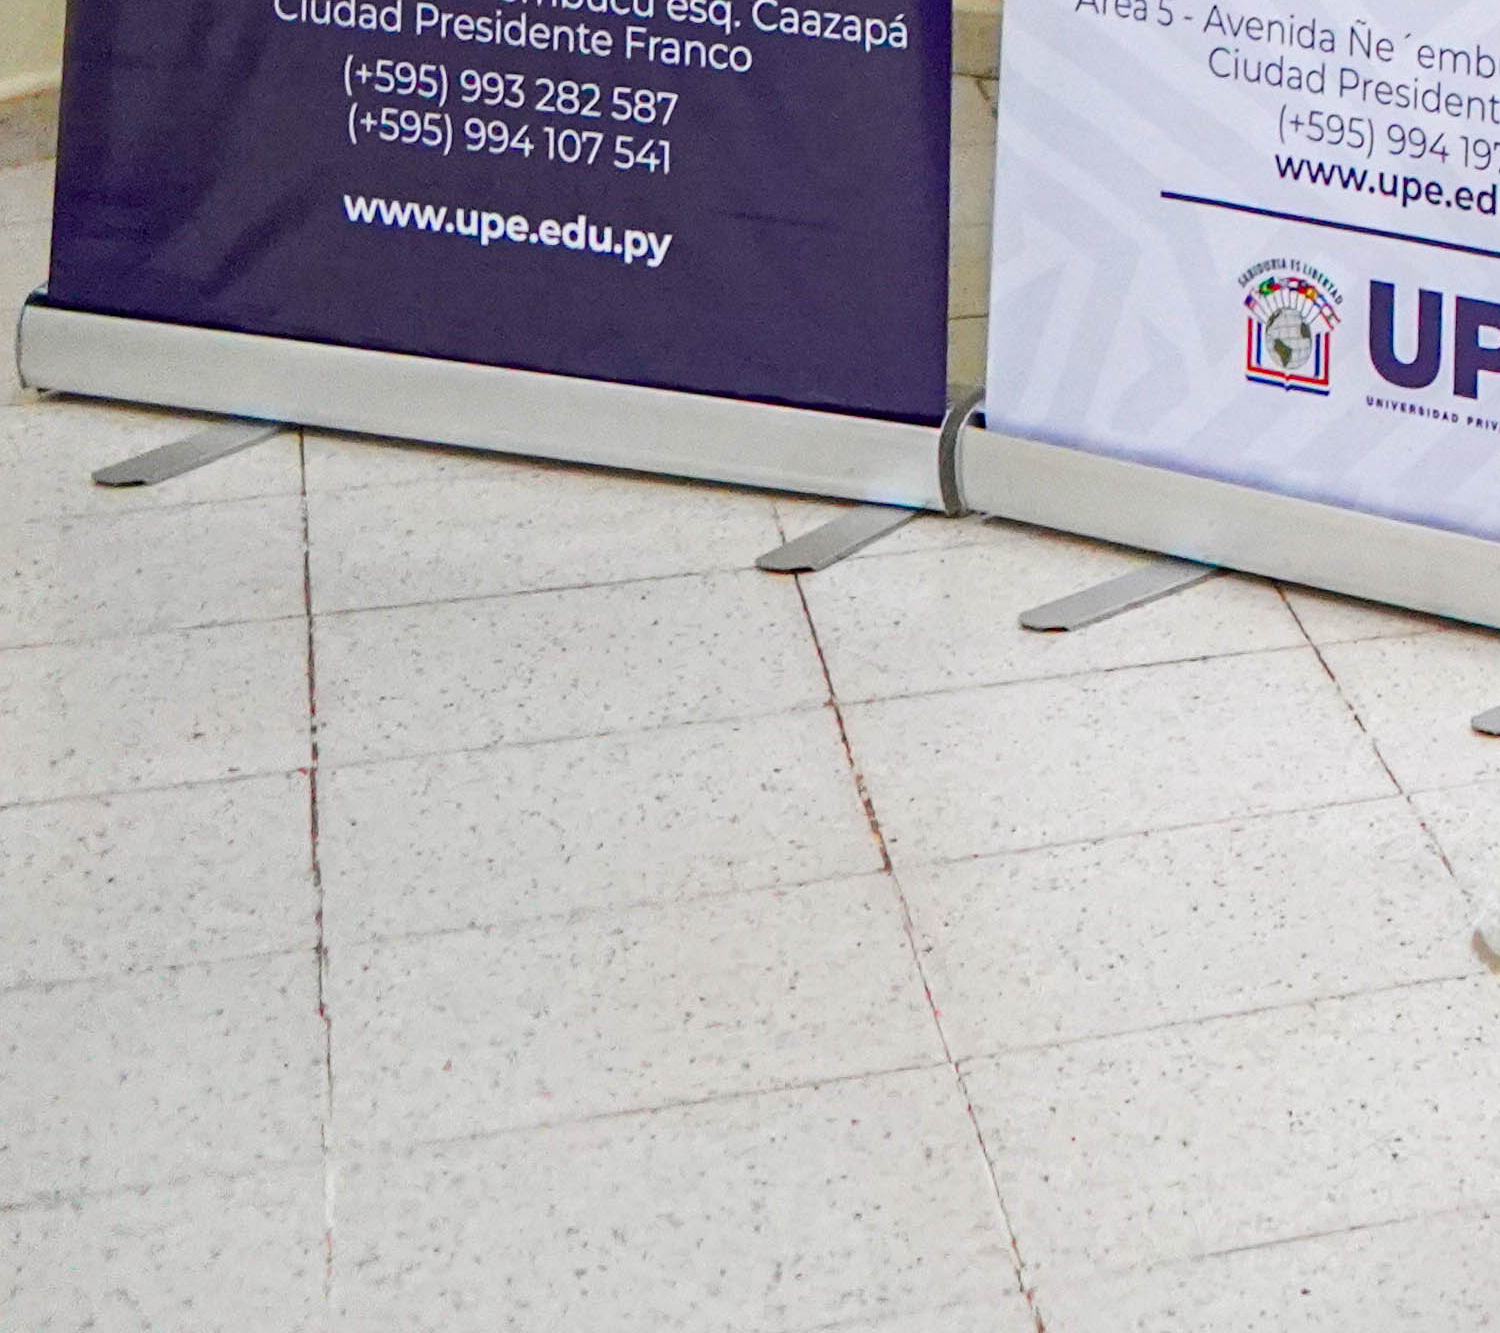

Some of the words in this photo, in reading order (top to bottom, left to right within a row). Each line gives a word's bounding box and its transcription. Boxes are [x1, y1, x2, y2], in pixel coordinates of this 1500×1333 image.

[414, 5, 614, 59] Presidente
[624, 27, 754, 73] Franco
[1203, 5, 1336, 56] Avenida
[343, 54, 450, 108] (+595)
[459, 69, 526, 110] 993
[534, 78, 601, 118] 282
[611, 87, 679, 127] 587
[1207, 46, 1327, 96] Ciudad
[348, 104, 454, 156] (+595)
[463, 118, 533, 159] 994
[543, 128, 603, 168] 107
[613, 136, 670, 175] 541
[1278, 103, 1377, 160] (+595)
[1386, 123, 1450, 164] 994
[343, 193, 673, 265] www.upe.edu.py
[1302, 264, 1343, 305] LIBERTAD
[1366, 395, 1459, 423] UNIVERSIDAD
